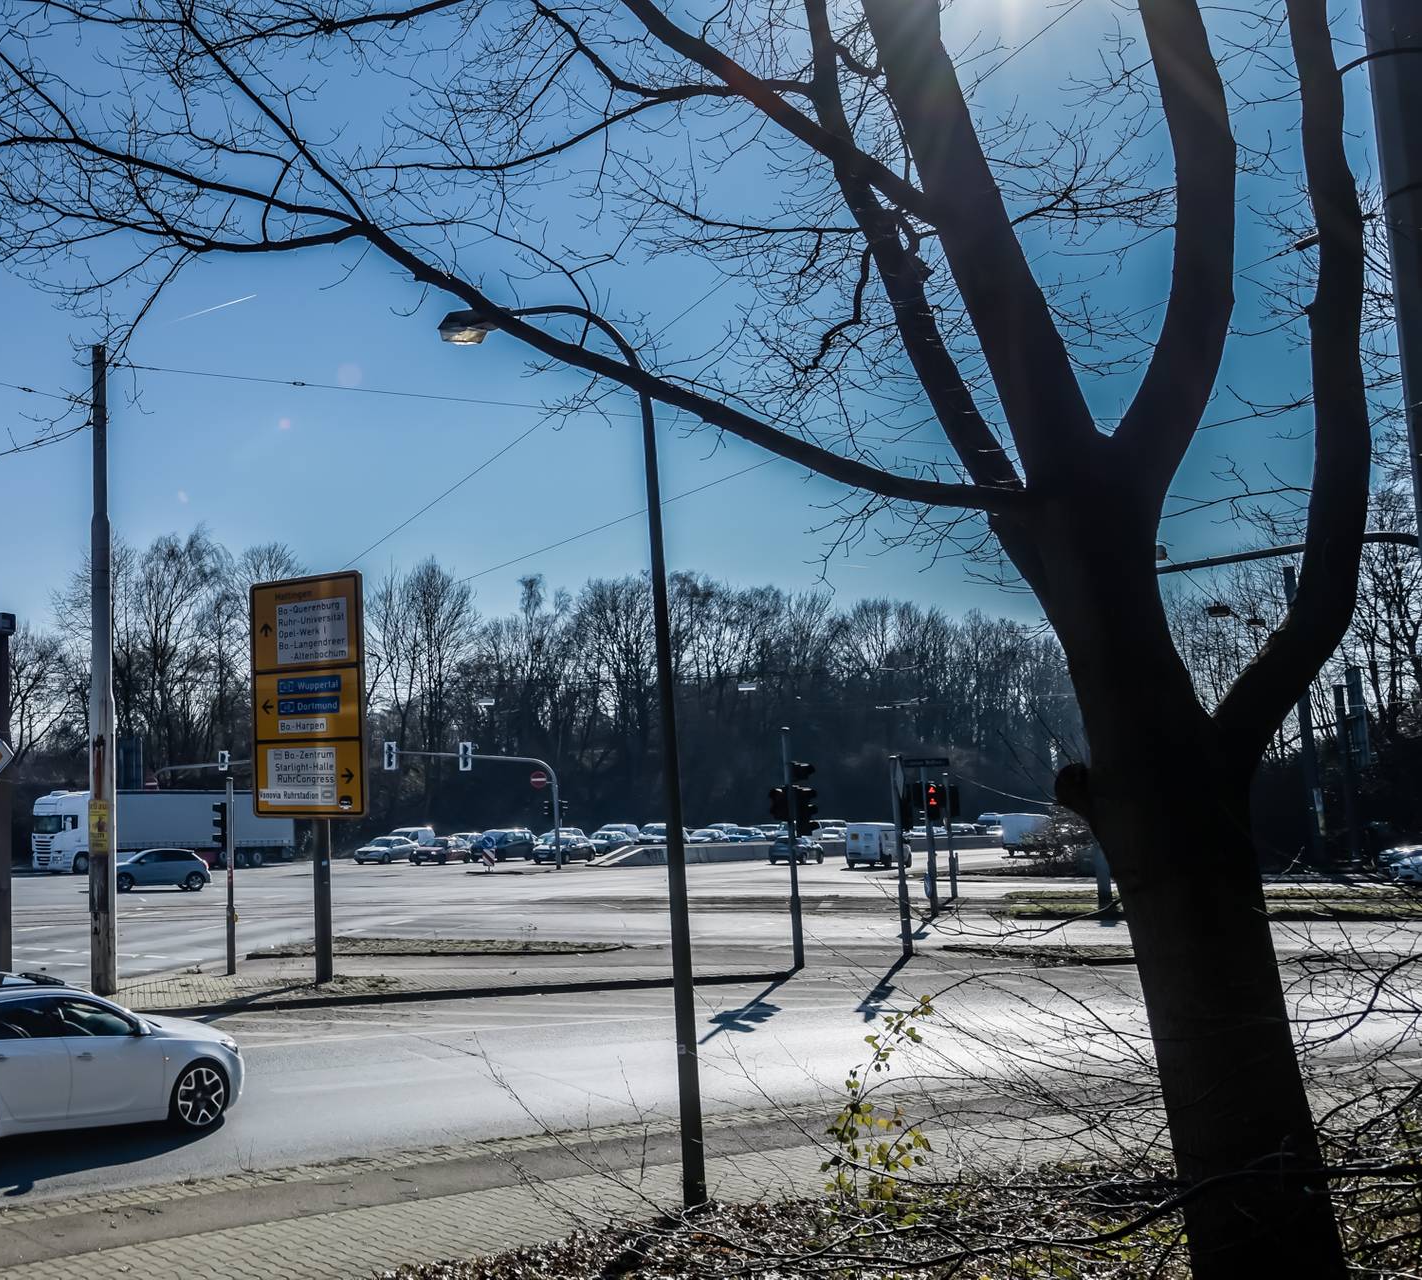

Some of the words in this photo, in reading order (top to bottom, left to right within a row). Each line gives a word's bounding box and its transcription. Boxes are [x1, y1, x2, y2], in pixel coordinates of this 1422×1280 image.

[278, 613, 345, 627] Ruhr-Universität
[298, 679, 339, 692] Wuppertal
[297, 701, 338, 711] Dortmund
[275, 762, 334, 773] Starlight-Halle
[277, 774, 335, 785] RuhrCongress
[283, 790, 319, 800] Ruhrstadion
